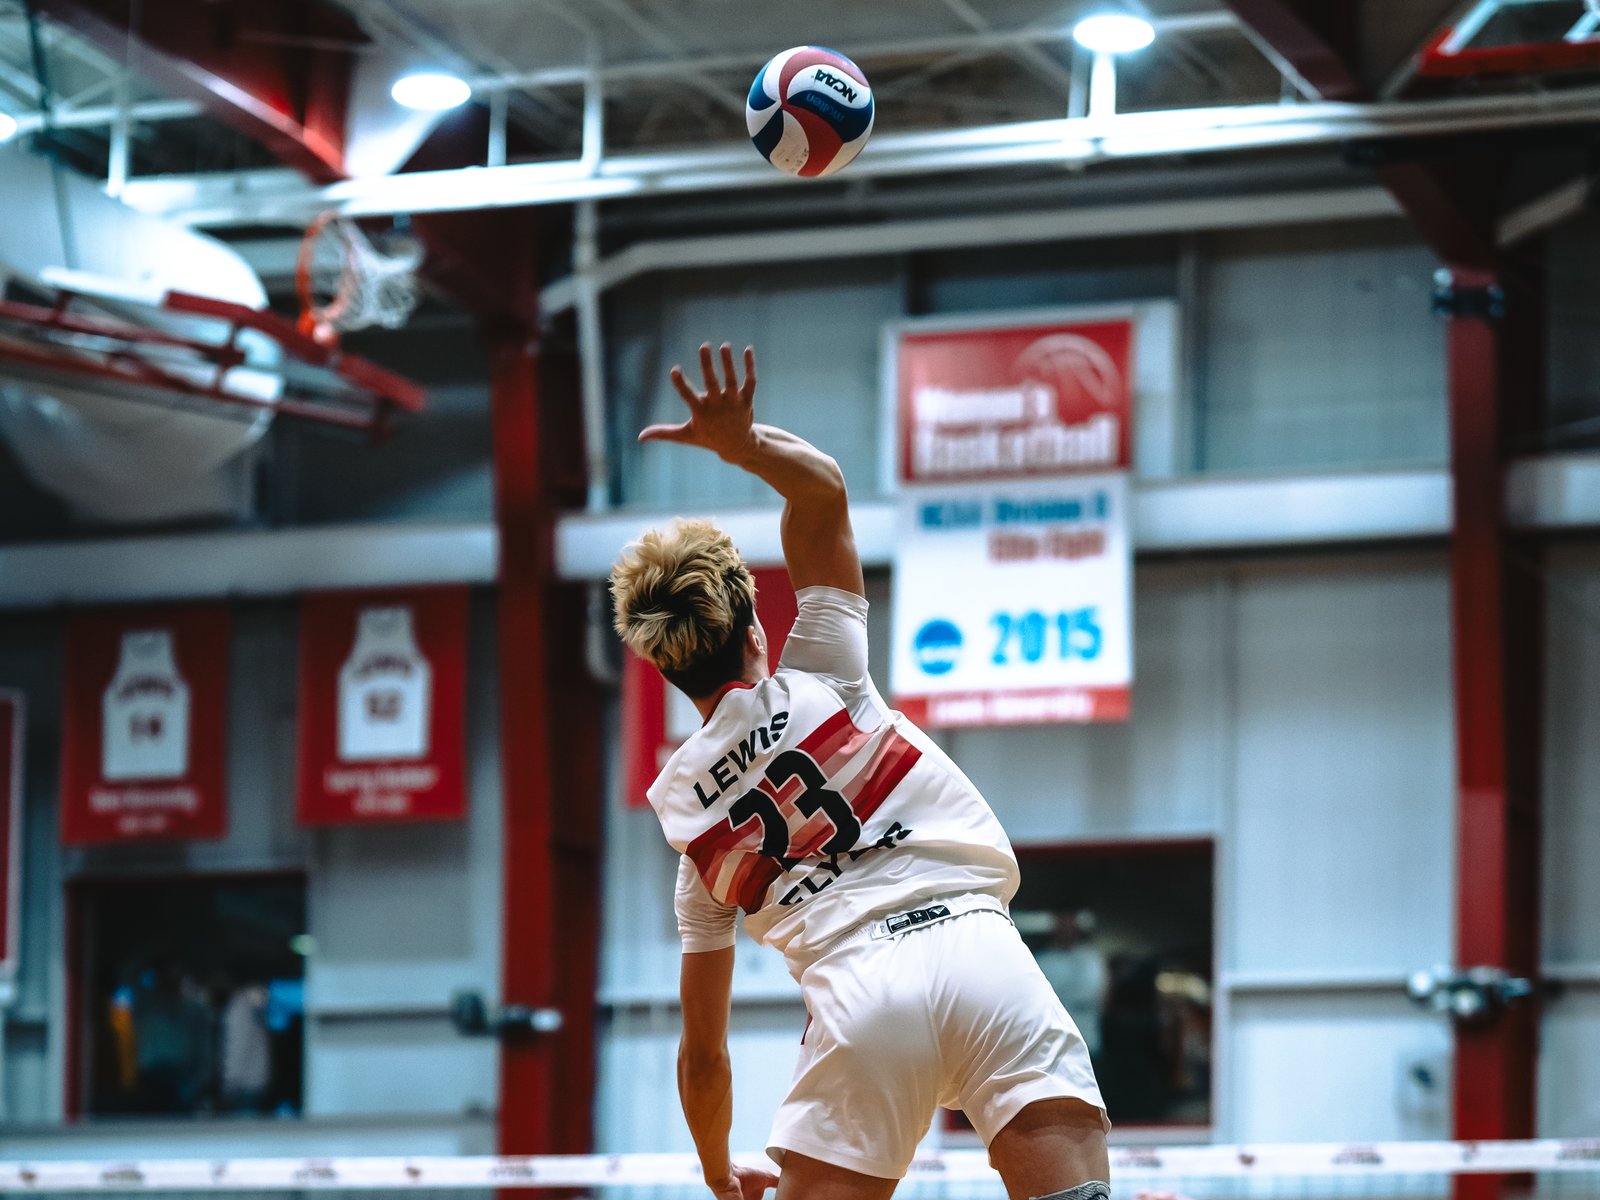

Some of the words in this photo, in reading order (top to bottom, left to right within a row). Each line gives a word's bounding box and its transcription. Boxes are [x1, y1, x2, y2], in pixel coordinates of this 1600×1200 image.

[815, 69, 857, 103] NCAA
[990, 605, 1102, 665] 2015
[693, 711, 789, 810] LEWIS
[727, 749, 861, 872] 23
